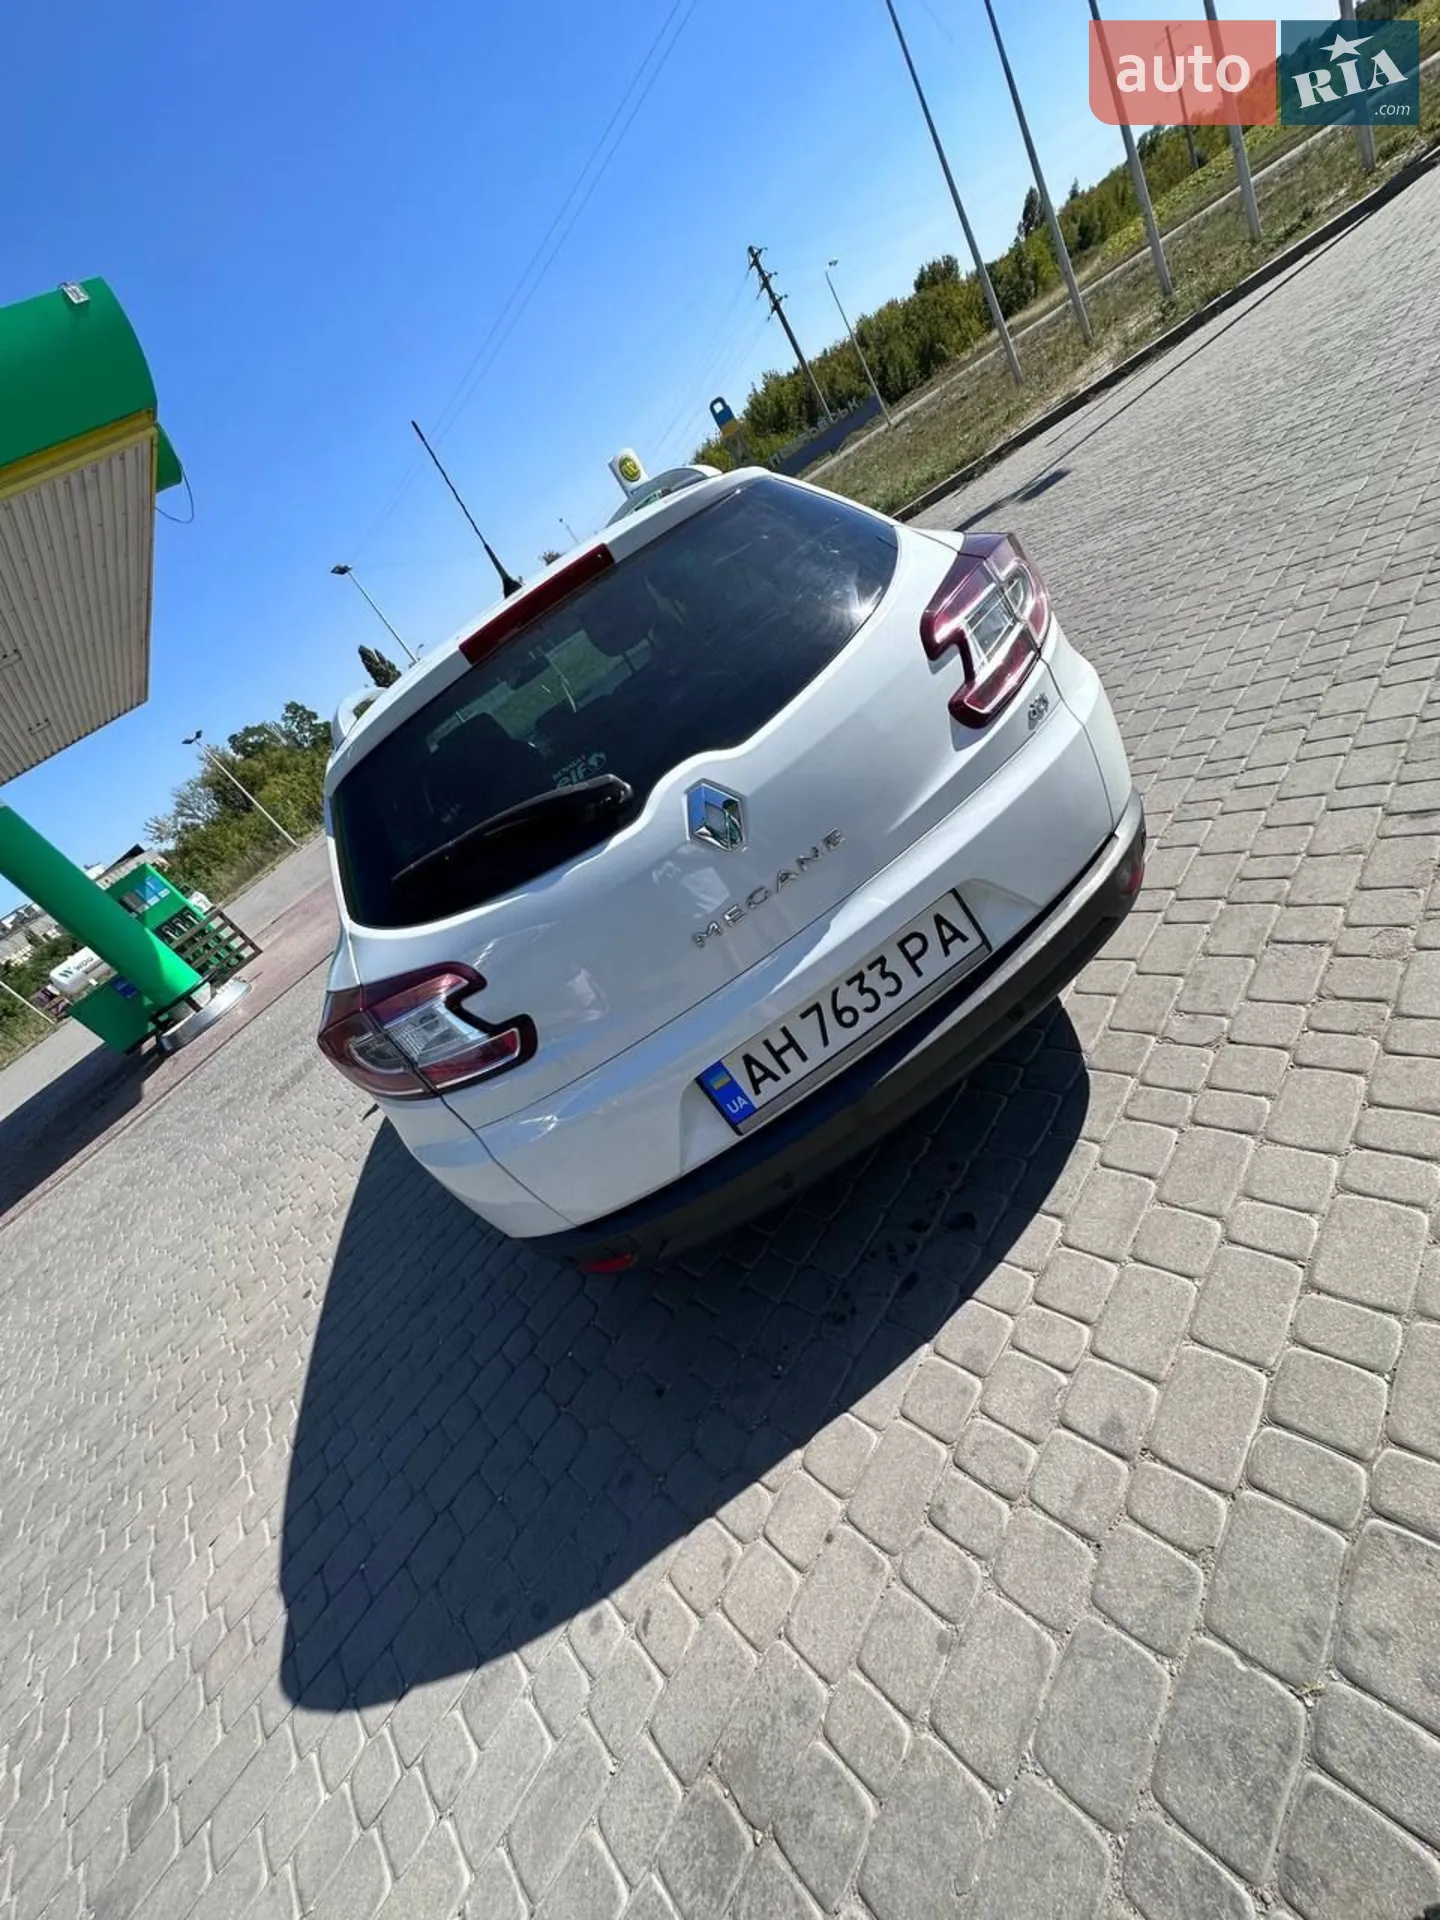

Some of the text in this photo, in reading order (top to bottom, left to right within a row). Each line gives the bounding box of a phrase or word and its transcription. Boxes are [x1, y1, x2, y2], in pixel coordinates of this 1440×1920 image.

[692, 828, 846, 948] MEGANE
[742, 912, 969, 1096] AH 7633 PA
[726, 1096, 749, 1113] UA
